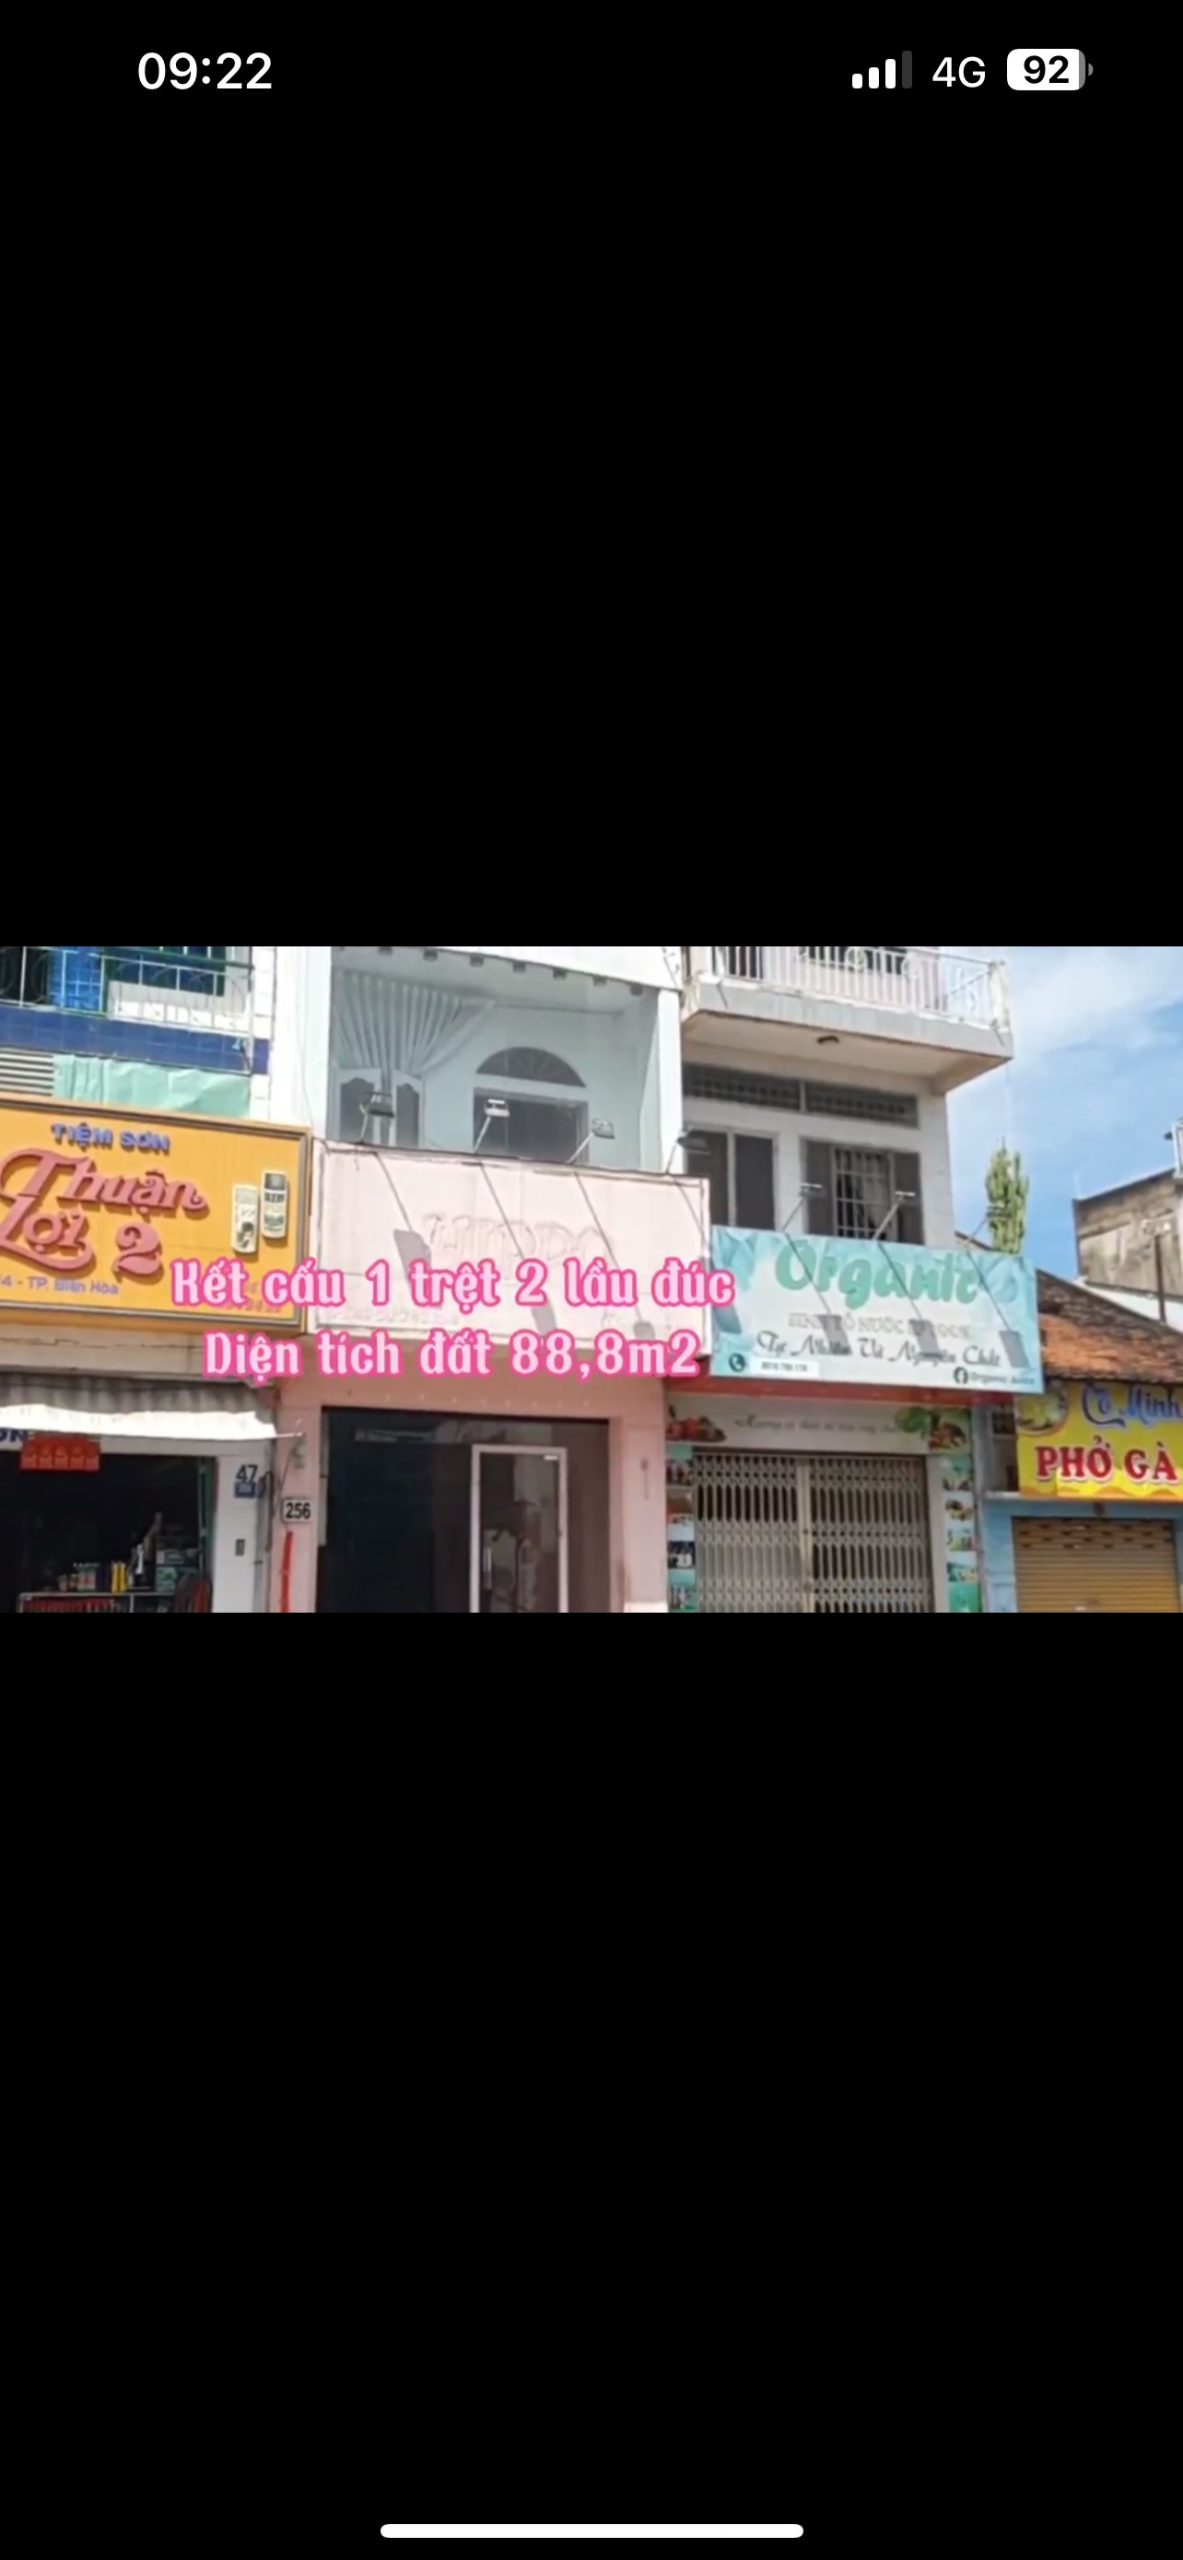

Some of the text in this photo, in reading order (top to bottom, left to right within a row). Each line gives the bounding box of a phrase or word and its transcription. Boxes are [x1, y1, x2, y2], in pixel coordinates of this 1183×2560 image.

[51, 1123, 170, 1155] TIỆM SƠN
[0, 1148, 209, 1216] Thuận
[113, 1222, 163, 1277] 2
[26, 1276, 49, 1292] TP.
[775, 1240, 981, 1310] Organic
[236, 1463, 258, 1484] 47
[1035, 1435, 1178, 1482] PHỞ GÀ
[285, 1501, 311, 1520] 256
